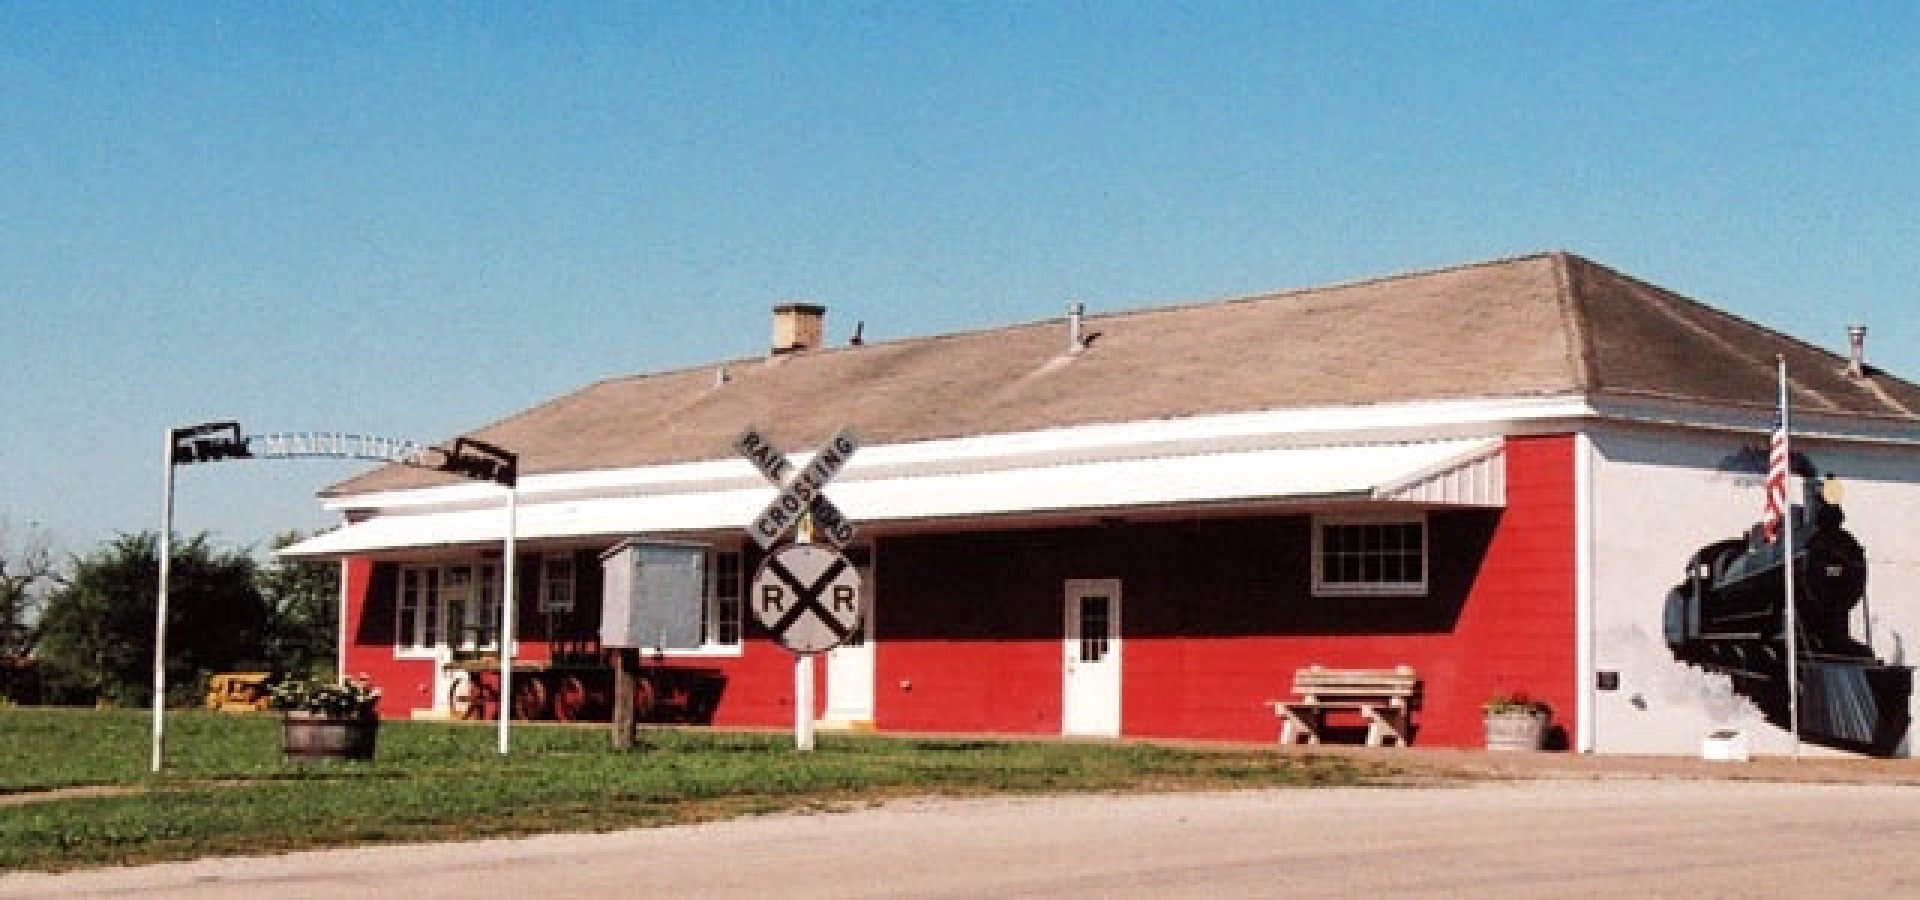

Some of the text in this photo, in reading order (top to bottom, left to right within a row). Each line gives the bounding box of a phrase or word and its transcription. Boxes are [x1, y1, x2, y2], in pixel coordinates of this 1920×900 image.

[743, 431, 785, 481] RAIL
[759, 436, 853, 537] CROSSING
[761, 584, 856, 613] R R
